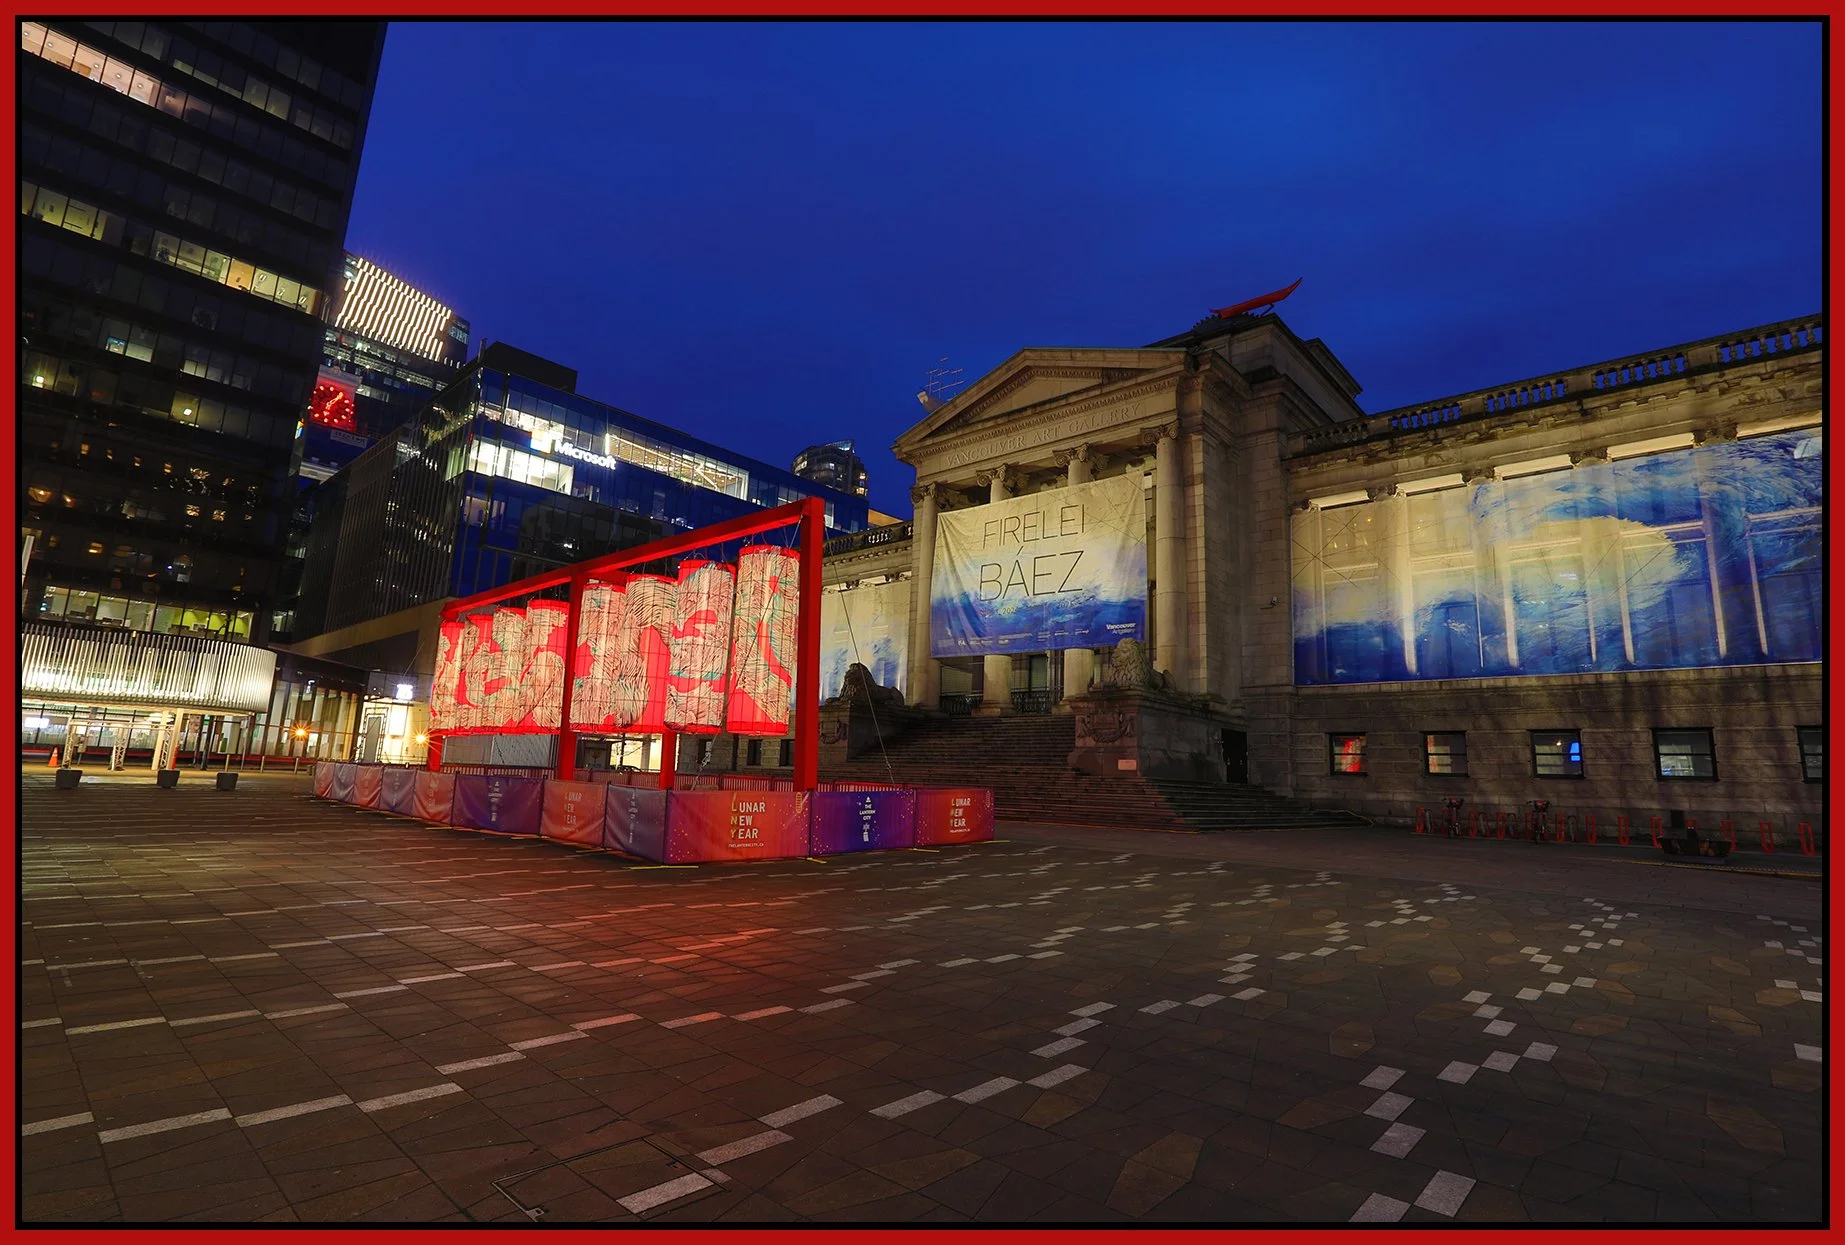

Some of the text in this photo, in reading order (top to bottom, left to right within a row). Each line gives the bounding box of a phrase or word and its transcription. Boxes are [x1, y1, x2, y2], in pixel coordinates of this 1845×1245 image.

[946, 402, 1140, 467] VANCOUVER ART GALLERY
[554, 439, 617, 470] Microsoft
[982, 503, 1085, 549] FIRELEI
[979, 545, 1085, 602] BÁEZ
[1105, 622, 1137, 630] Vancouver
[731, 795, 766, 813] LUNAR
[951, 797, 971, 807] LUNAR
[730, 815, 753, 826] NEW
[730, 828, 759, 839] YEAR
